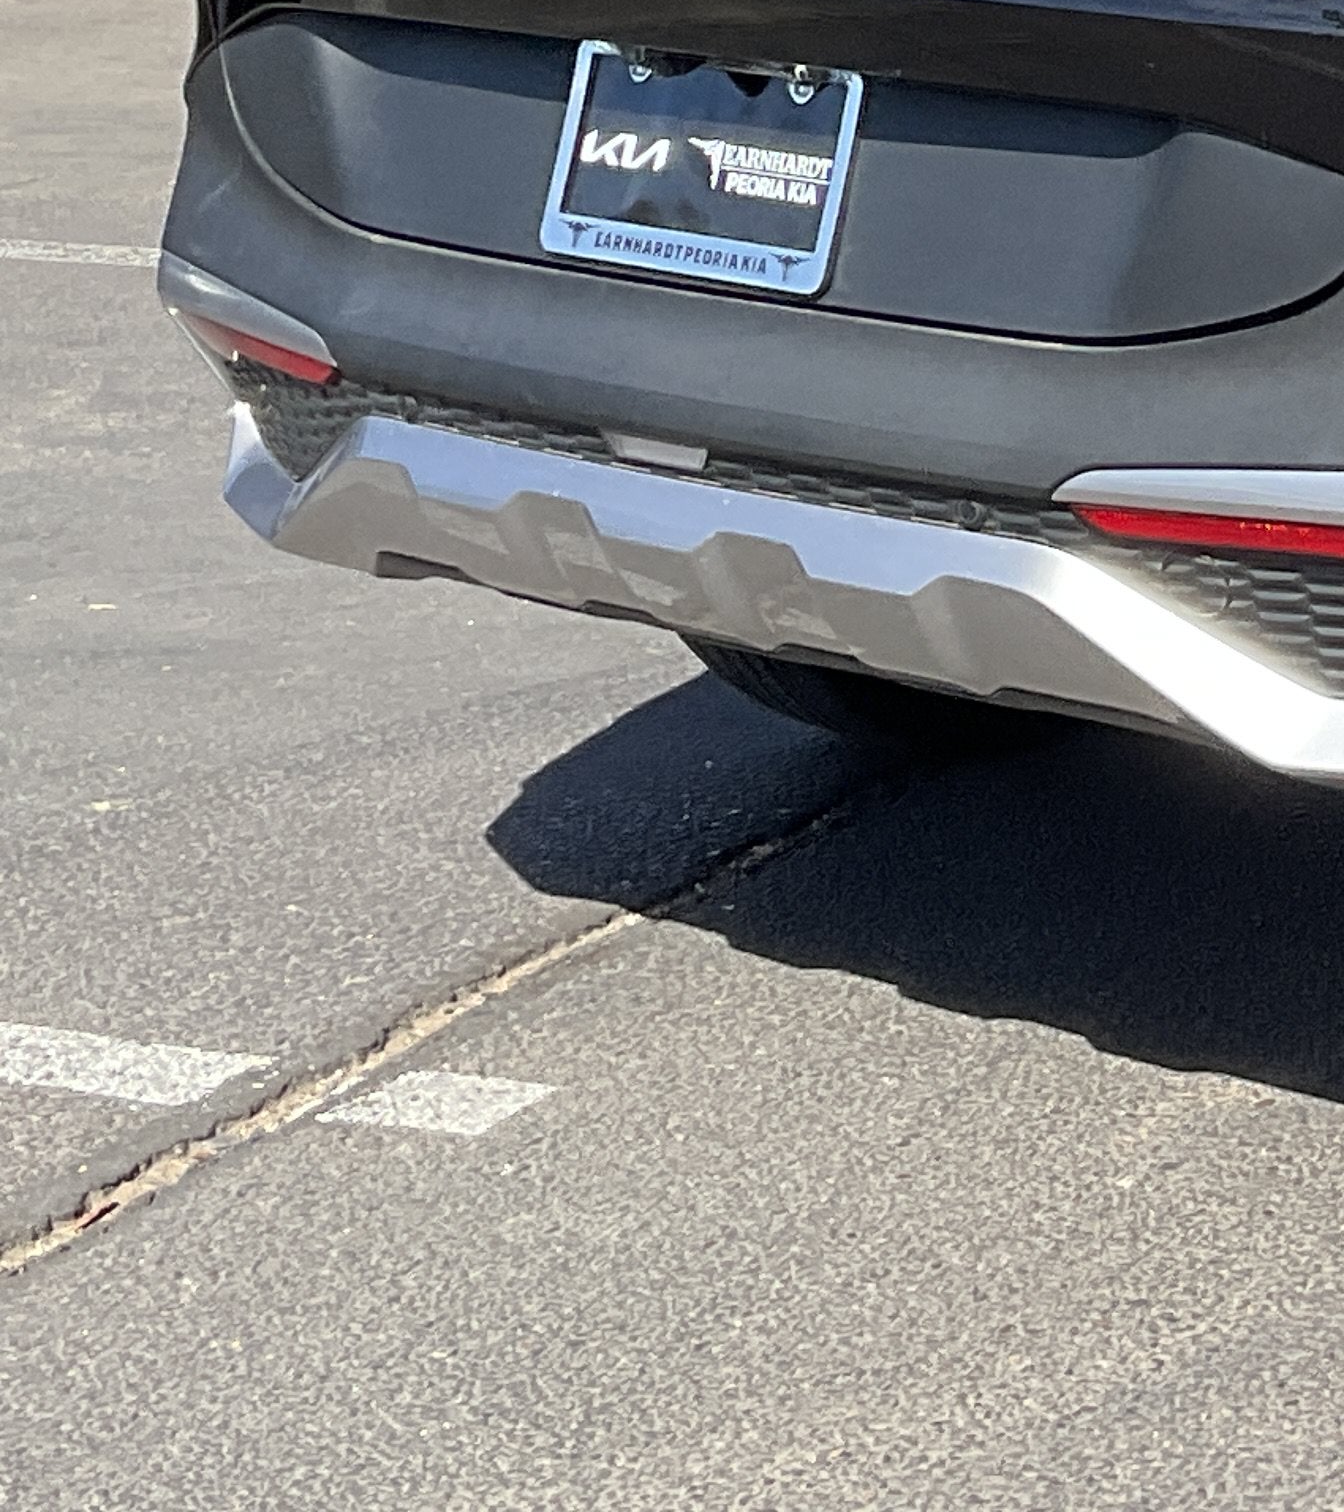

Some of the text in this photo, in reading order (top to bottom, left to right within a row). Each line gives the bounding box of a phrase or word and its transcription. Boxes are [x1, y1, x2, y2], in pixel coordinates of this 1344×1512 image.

[579, 129, 672, 172] KIA
[721, 143, 834, 180] EARNHARDT
[723, 172, 818, 206] PEORIA KIA
